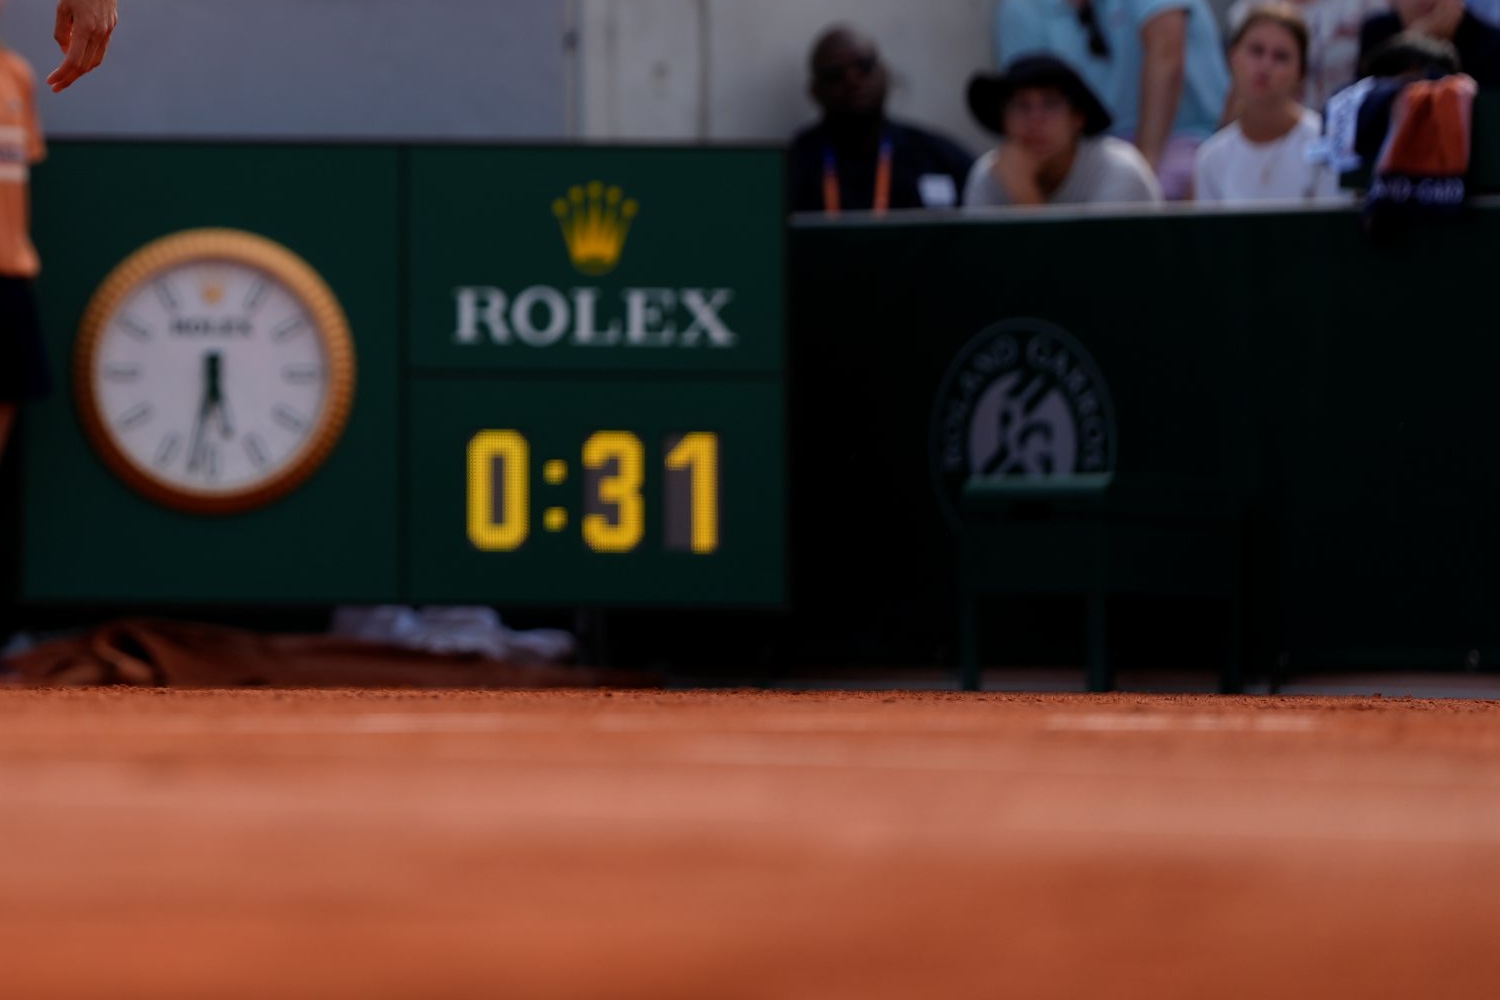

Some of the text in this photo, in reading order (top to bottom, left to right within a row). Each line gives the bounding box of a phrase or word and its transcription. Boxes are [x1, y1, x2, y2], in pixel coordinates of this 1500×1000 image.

[453, 284, 738, 347] ROLEX
[941, 332, 1020, 474] ROLAND
[466, 429, 718, 554] 0:31
